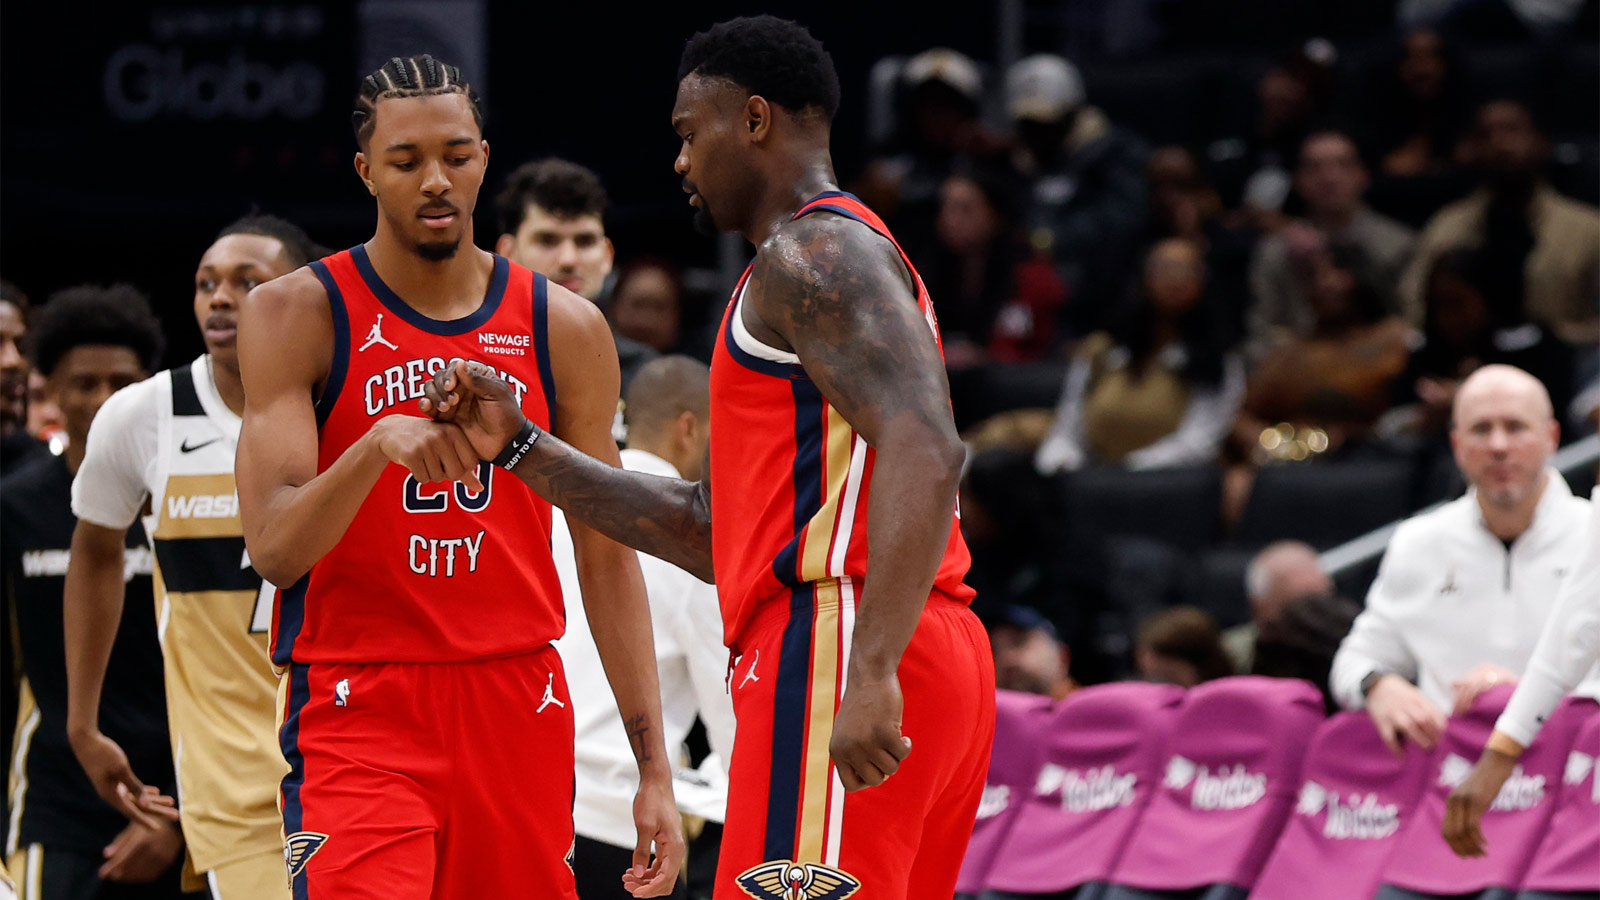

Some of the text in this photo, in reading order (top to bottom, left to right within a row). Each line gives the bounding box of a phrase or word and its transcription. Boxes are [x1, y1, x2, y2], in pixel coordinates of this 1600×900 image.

[478, 332, 530, 349] NEWAGE
[483, 346, 526, 357] PRODUCTS
[519, 444, 530, 454] TO
[527, 431, 539, 445] DIE
[408, 530, 486, 578] CITY
